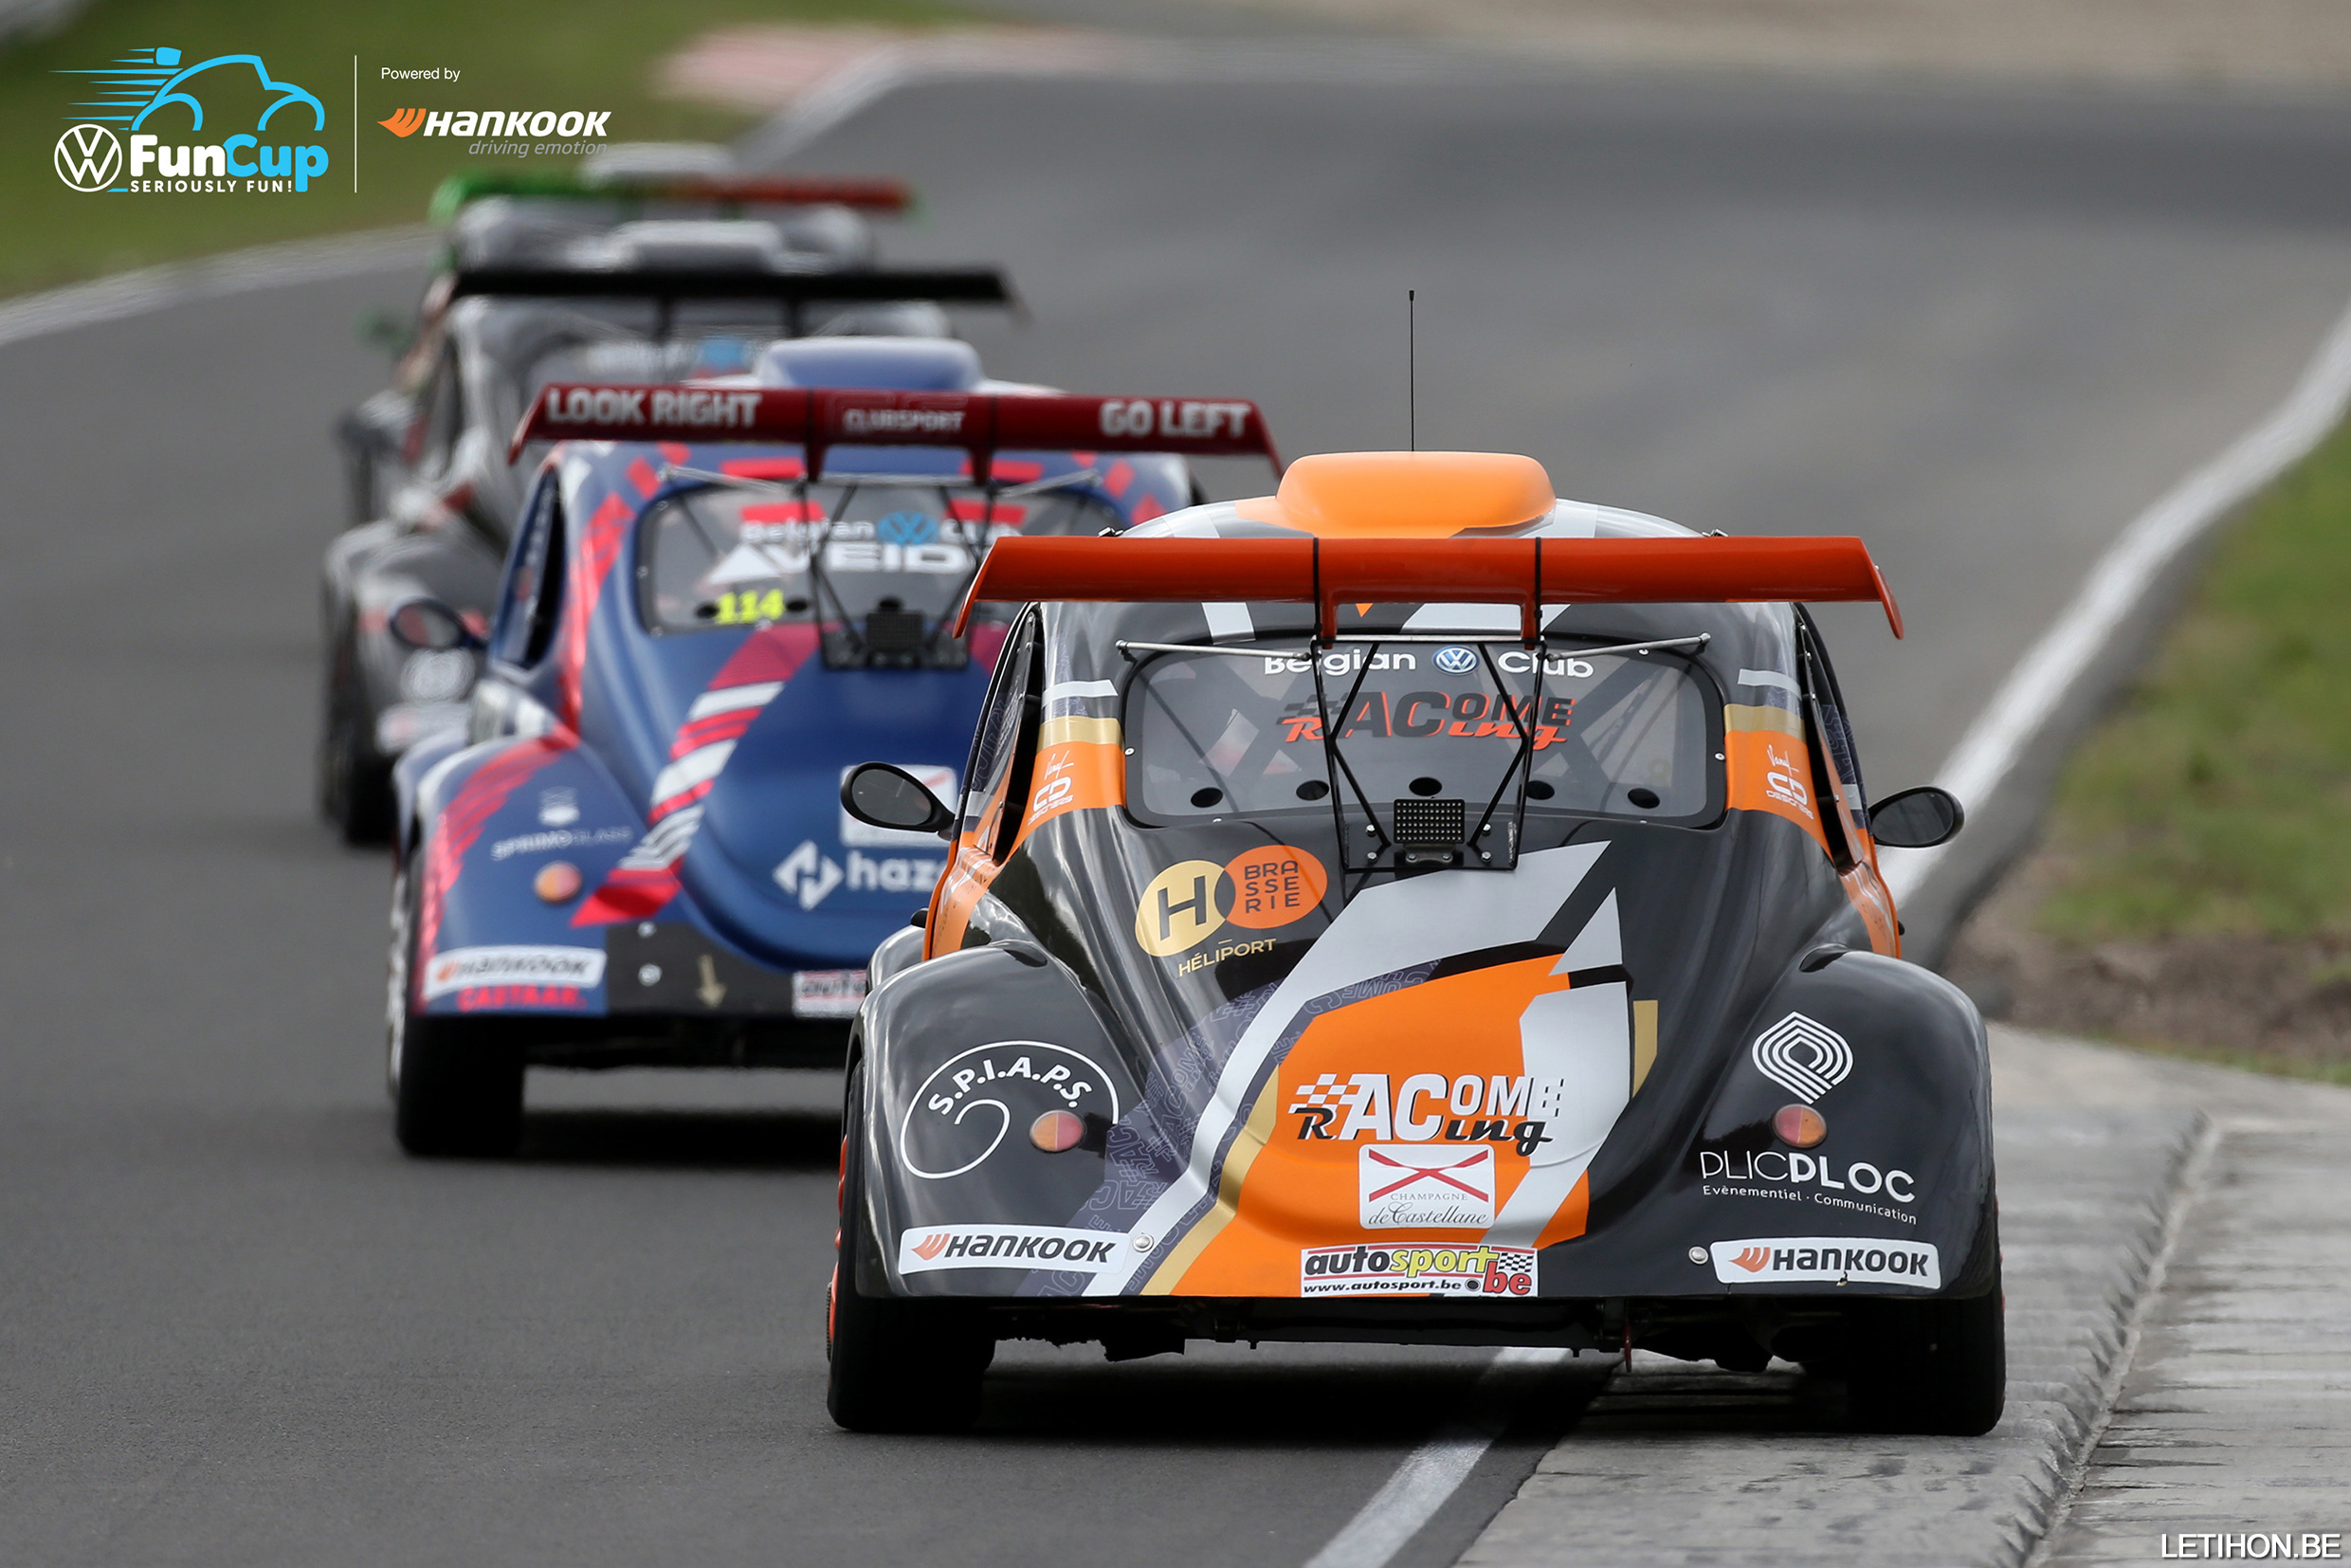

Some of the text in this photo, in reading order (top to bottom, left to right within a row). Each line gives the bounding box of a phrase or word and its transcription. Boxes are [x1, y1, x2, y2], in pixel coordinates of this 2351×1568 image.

[545, 387, 763, 427] LOOK RIGHT
[843, 409, 965, 433] CLUBSPORT
[1100, 401, 1251, 438] GO LEFT
[714, 590, 785, 626] 114
[1265, 648, 1416, 676] Begian
[1498, 650, 1595, 679] Club
[847, 850, 947, 891] haz
[1157, 875, 1207, 941] H
[1178, 938, 1277, 977] HÉLIPORT
[928, 1057, 1093, 1116] S.P.I.A.P.S.
[1390, 1193, 1468, 1202] CHAMPAGNE
[1703, 1184, 1917, 1225] Evènementiel Communication
[1303, 1279, 1462, 1294] www.autosport.be
